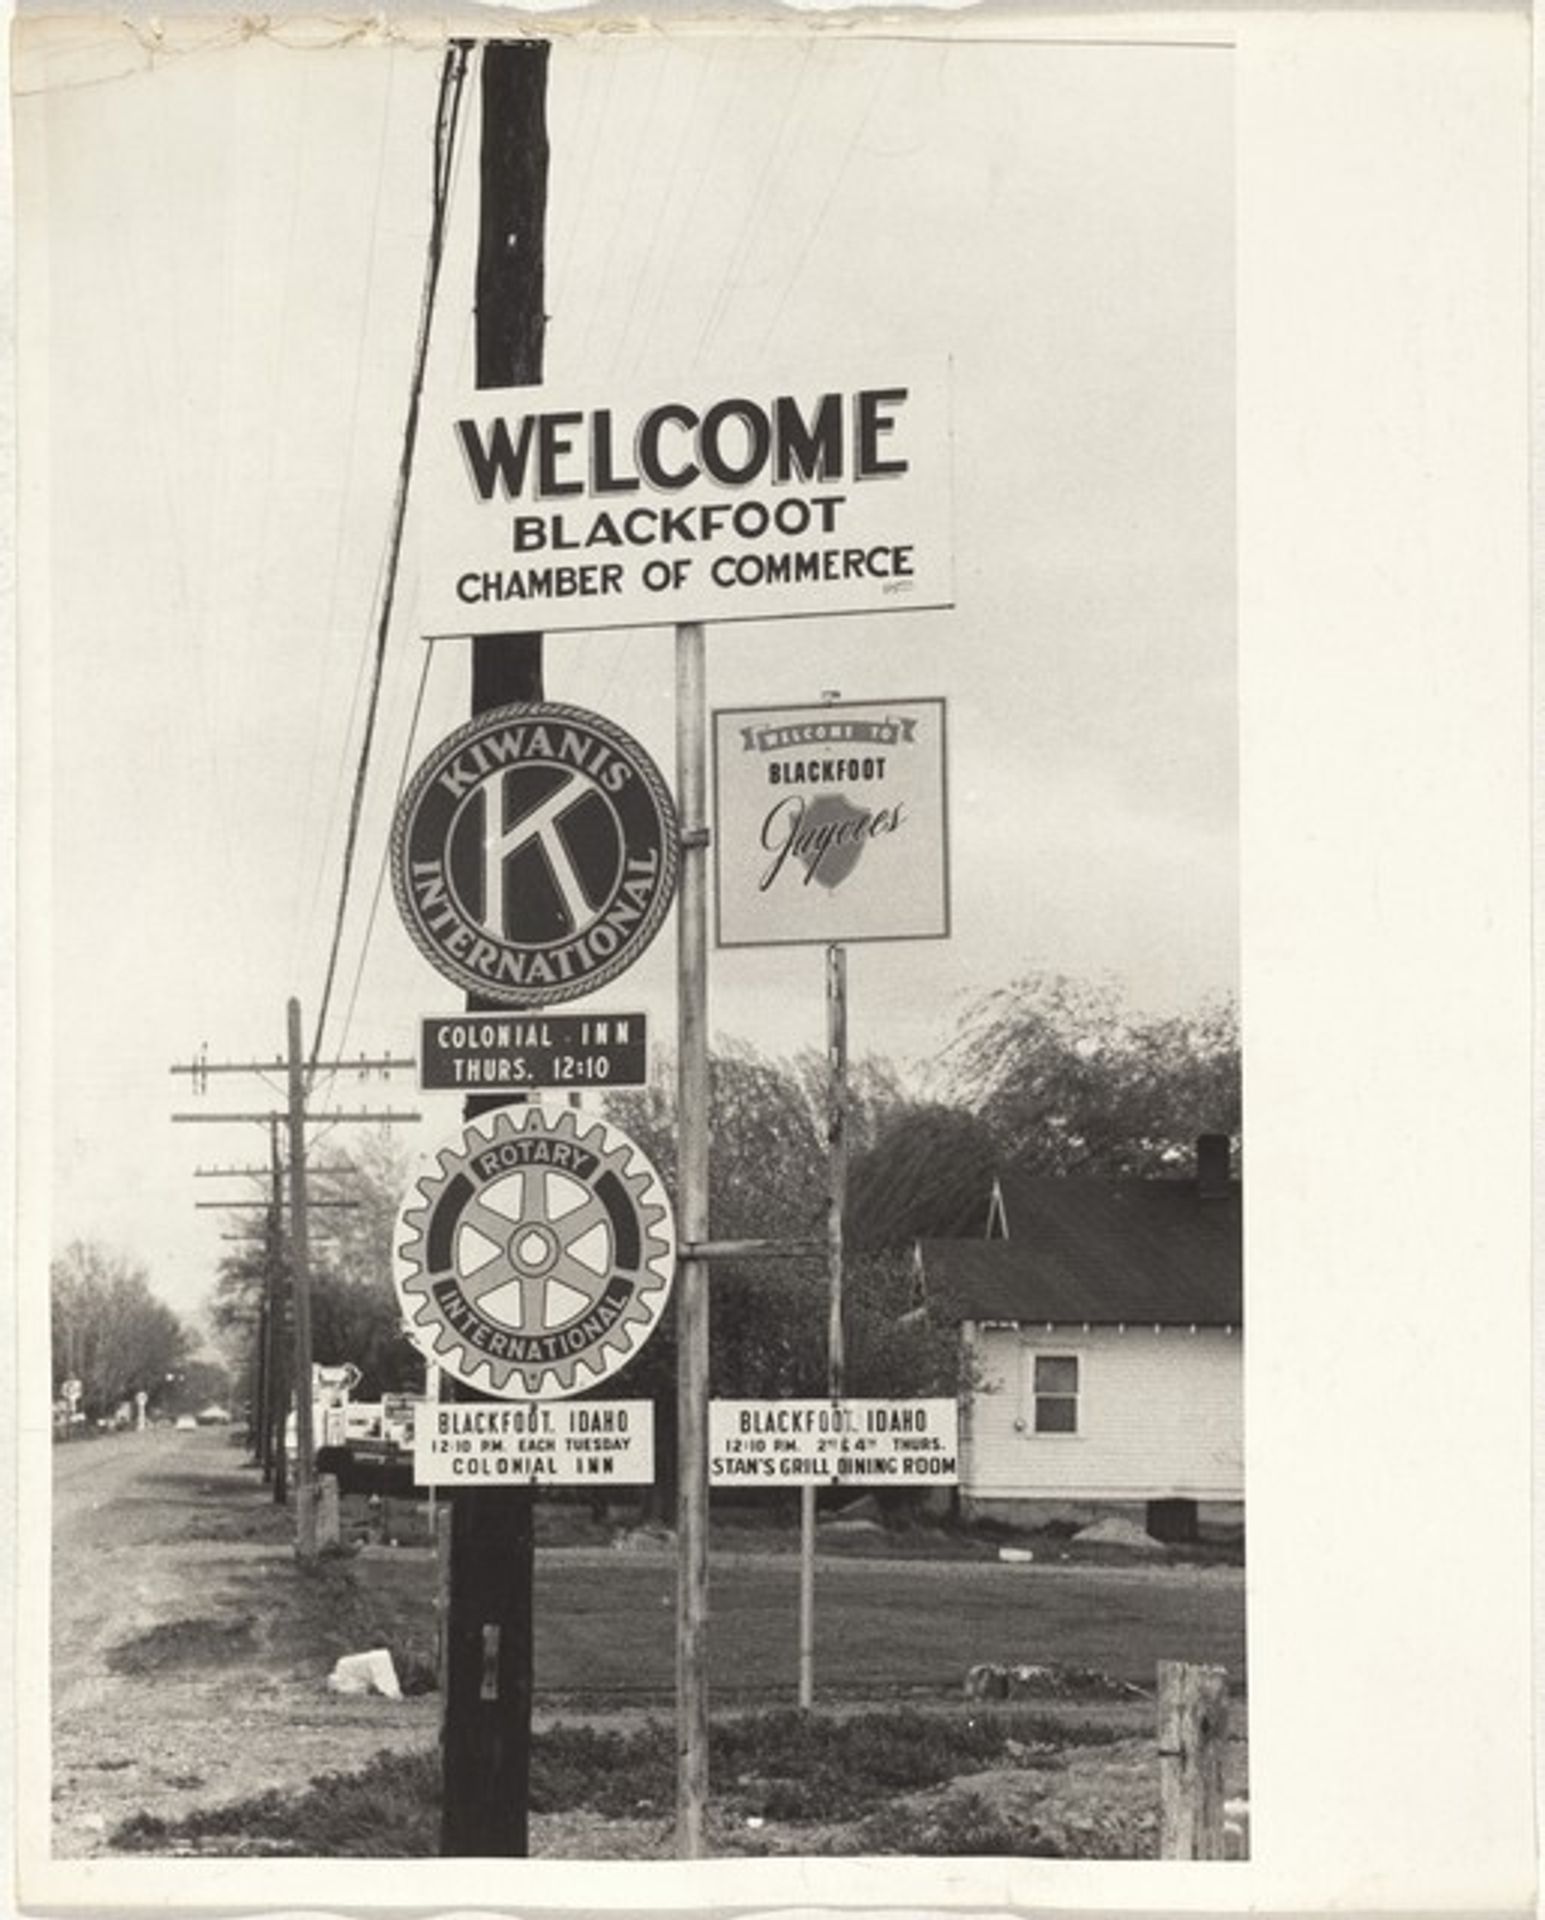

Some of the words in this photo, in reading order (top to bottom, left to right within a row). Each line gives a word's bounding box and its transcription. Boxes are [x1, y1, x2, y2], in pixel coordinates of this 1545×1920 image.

[454, 387, 909, 503] WELCOME
[513, 496, 847, 553] BLACKFOOT
[455, 562, 624, 604] CHAMBER
[642, 558, 692, 591] OF
[711, 545, 915, 588] COMMERCE
[764, 723, 853, 747] WELCOME
[870, 725, 893, 740] TO
[439, 725, 633, 799] KIWANIS
[768, 756, 887, 785] BLACKFOOT
[481, 769, 604, 943] K
[411, 847, 659, 984] INTERNATIONAL
[437, 1022, 553, 1049] COLONIAL
[581, 1020, 630, 1046] INN
[452, 1057, 535, 1082] THURS.
[553, 1055, 611, 1081] 12:10
[480, 1140, 590, 1176] ROTARY
[437, 1288, 632, 1363] INTERNATIONAL
[569, 1409, 630, 1433] IDAHO
[867, 1408, 927, 1433] IDAHO
[518, 1439, 557, 1453] EACH
[565, 1437, 632, 1451] TUESDAY
[725, 1439, 767, 1453] 12:10
[892, 1437, 946, 1451] THURS.
[452, 1457, 559, 1475] COLONIAL
[576, 1456, 614, 1474] INN
[712, 1456, 776, 1476] STAN'S
[780, 1457, 830, 1475] GRILL
[837, 1456, 899, 1475] DINING
[903, 1456, 956, 1474] ROOM
